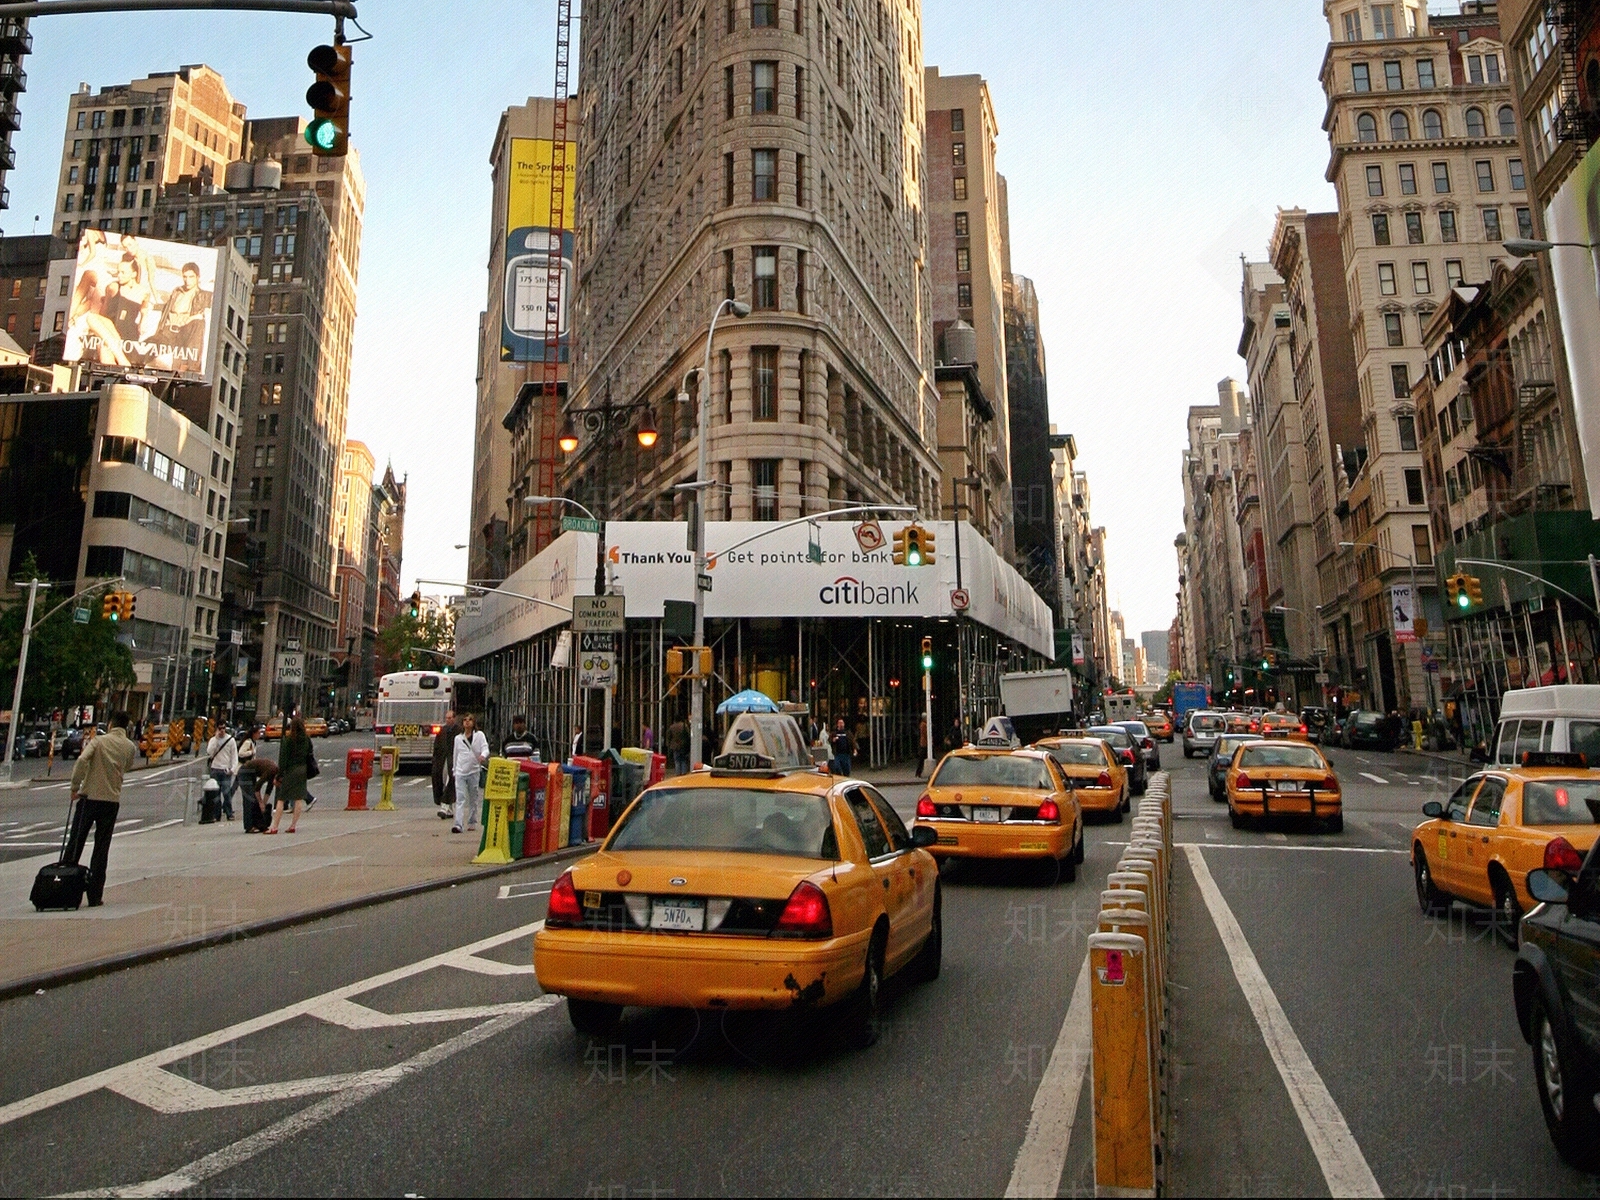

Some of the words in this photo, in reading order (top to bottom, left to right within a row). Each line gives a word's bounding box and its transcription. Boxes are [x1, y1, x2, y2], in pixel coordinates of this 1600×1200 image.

[521, 304, 534, 312] 550
[150, 342, 199, 362] ARMANI
[563, 519, 599, 531] BROADWAY
[622, 552, 664, 564] Thank
[666, 552, 692, 564] You
[728, 551, 754, 563] Get
[761, 550, 812, 566] points
[820, 550, 846, 563] for
[852, 550, 895, 563] banki
[819, 577, 920, 605] citibank
[591, 600, 607, 609] NO
[578, 610, 620, 618] COMMERCIAL
[592, 642, 613, 650] LANE
[284, 657, 297, 666] NO
[278, 667, 302, 677] TURNS
[729, 755, 757, 769] 5N70
